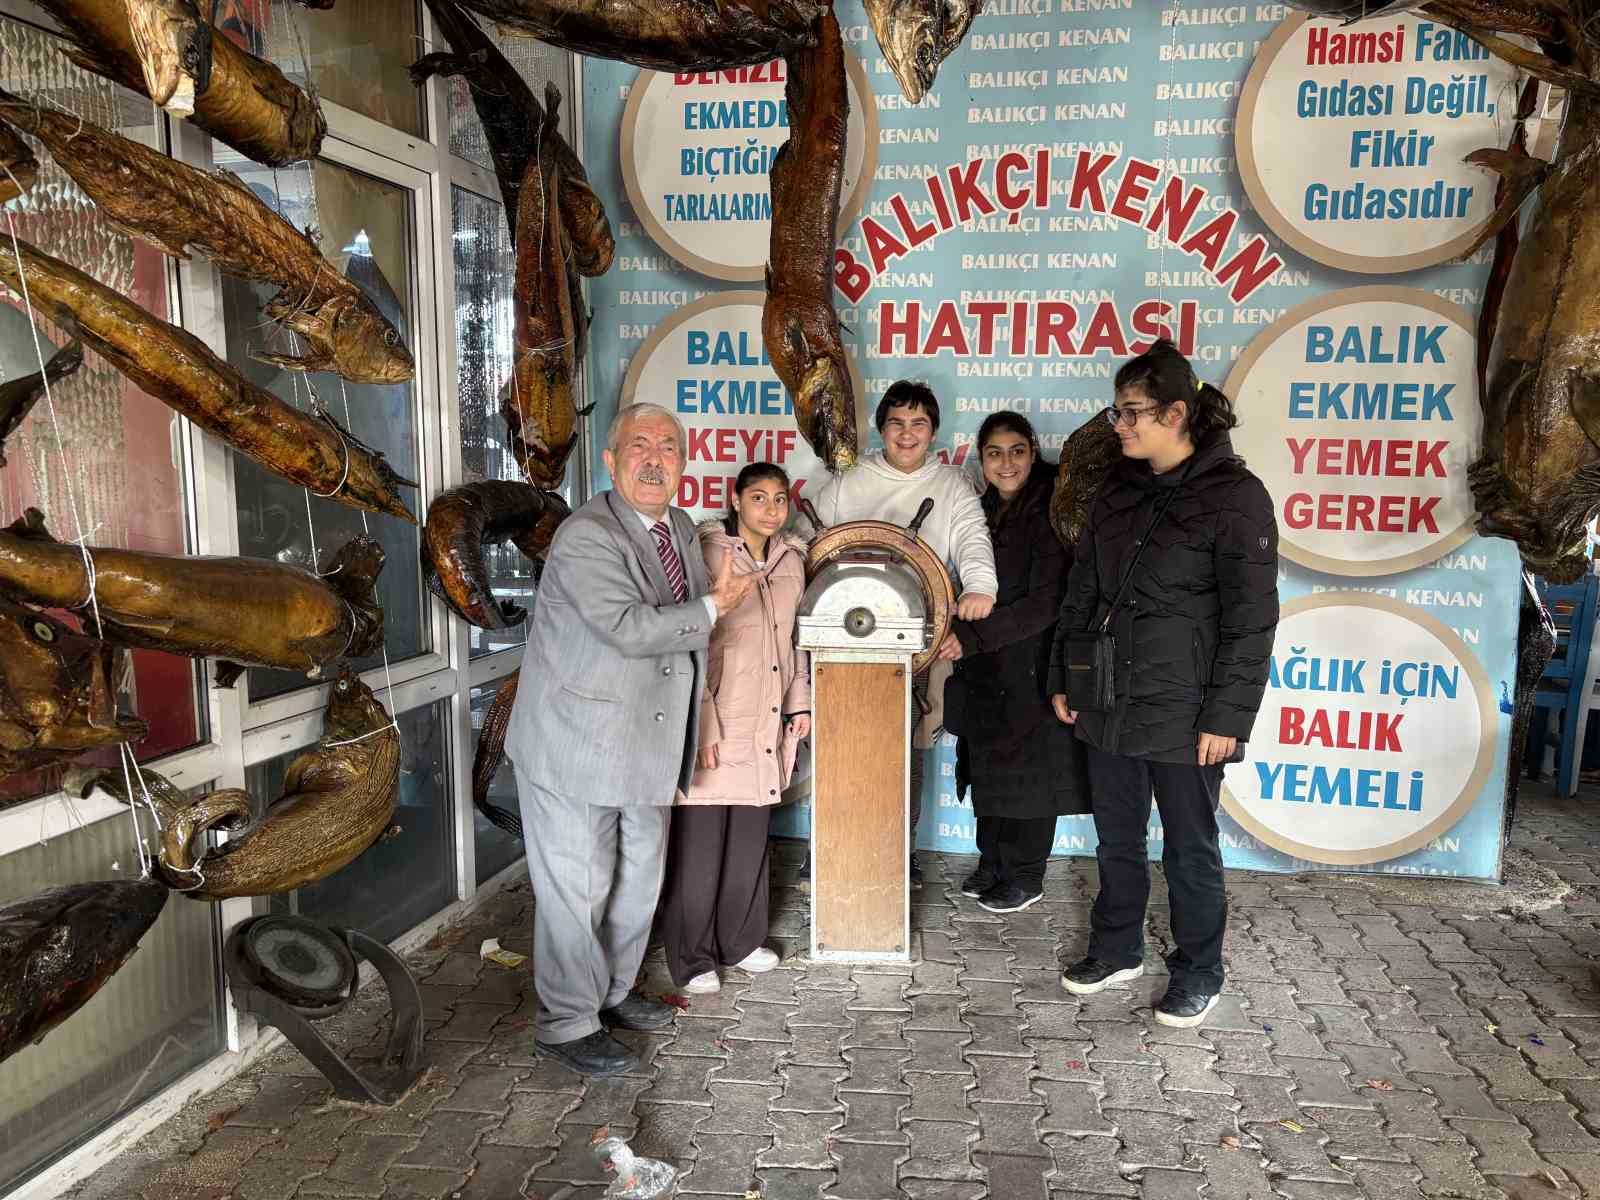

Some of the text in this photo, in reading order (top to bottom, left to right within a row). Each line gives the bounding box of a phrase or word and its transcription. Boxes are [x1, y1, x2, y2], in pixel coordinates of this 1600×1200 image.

[1161, 6, 1247, 27] BALIKÇI
[970, 27, 1131, 52] BALIKÇI KENAN
[1159, 41, 1244, 62] BALIKÇI
[1306, 25, 1405, 66] Hamsi
[969, 66, 1128, 90] BALIKÇI KENAN
[1296, 75, 1496, 119] Gıdası Değil,
[967, 102, 1127, 126] BALIKÇI KENAN
[1350, 130, 1435, 169] Fikir
[1304, 180, 1474, 221] Gıdasıdır
[833, 147, 1286, 306] BALIKÇI KENAN
[1049, 216, 1119, 232] KENAN
[961, 252, 1117, 272] BALIKÇI KENAN
[1145, 271, 1219, 290] BALIKÇ
[619, 290, 687, 308] BALIKÇI
[876, 297, 1199, 359] HATIRASI
[1304, 325, 1449, 364] BALIK
[957, 361, 1111, 381] BALIKÇI KENAN
[1288, 382, 1457, 422] EKMEK
[1285, 437, 1450, 478] YEMEK
[1283, 493, 1442, 534] GEREK
[1405, 588, 1484, 608] KENAN
[1278, 706, 1406, 753] BALIK
